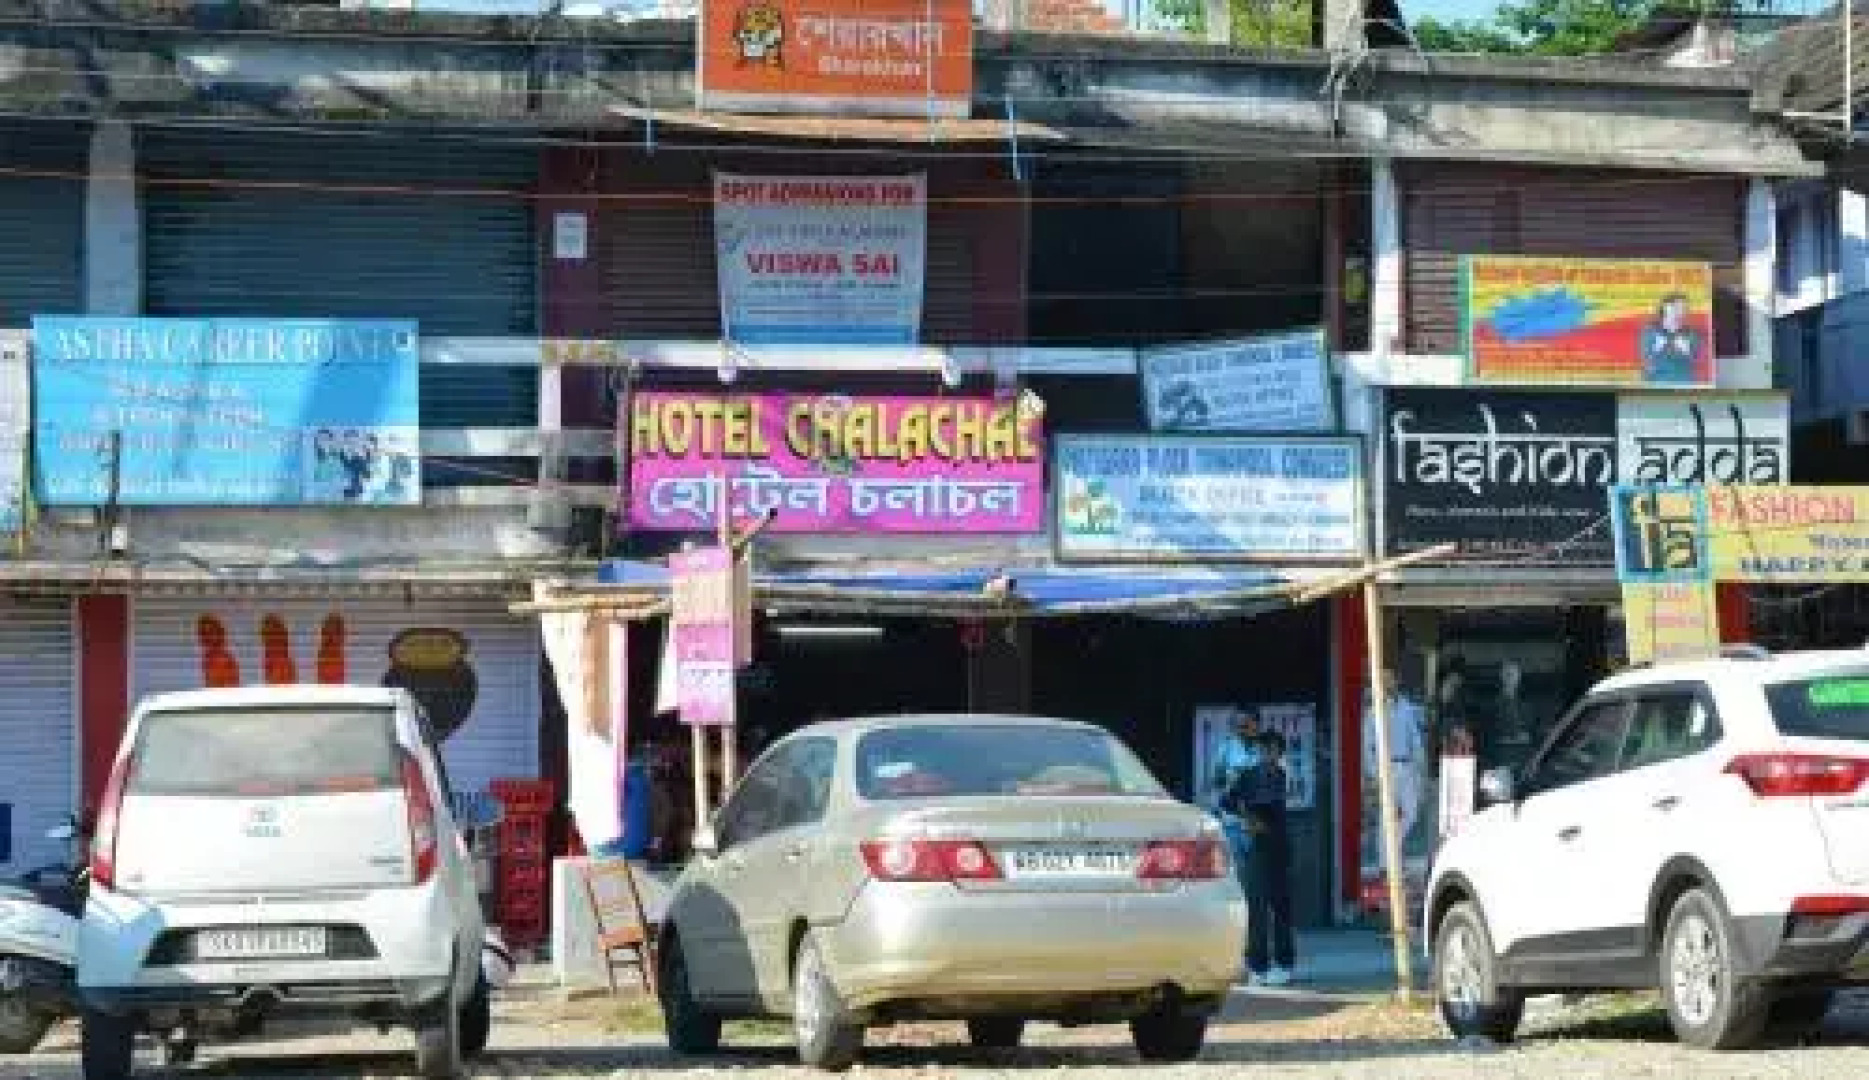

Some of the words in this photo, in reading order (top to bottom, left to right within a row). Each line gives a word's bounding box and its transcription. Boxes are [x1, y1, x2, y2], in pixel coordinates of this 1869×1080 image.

[746, 253, 842, 275] VISWA
[851, 253, 899, 276] SAI
[632, 399, 772, 457] HOTEL
[784, 397, 1041, 462] CHALACHAL
[1390, 402, 1615, 495] fashion
[1634, 403, 1784, 485] adda
[848, 474, 1026, 518] চলাচল
[1710, 488, 1855, 524] FASHION
